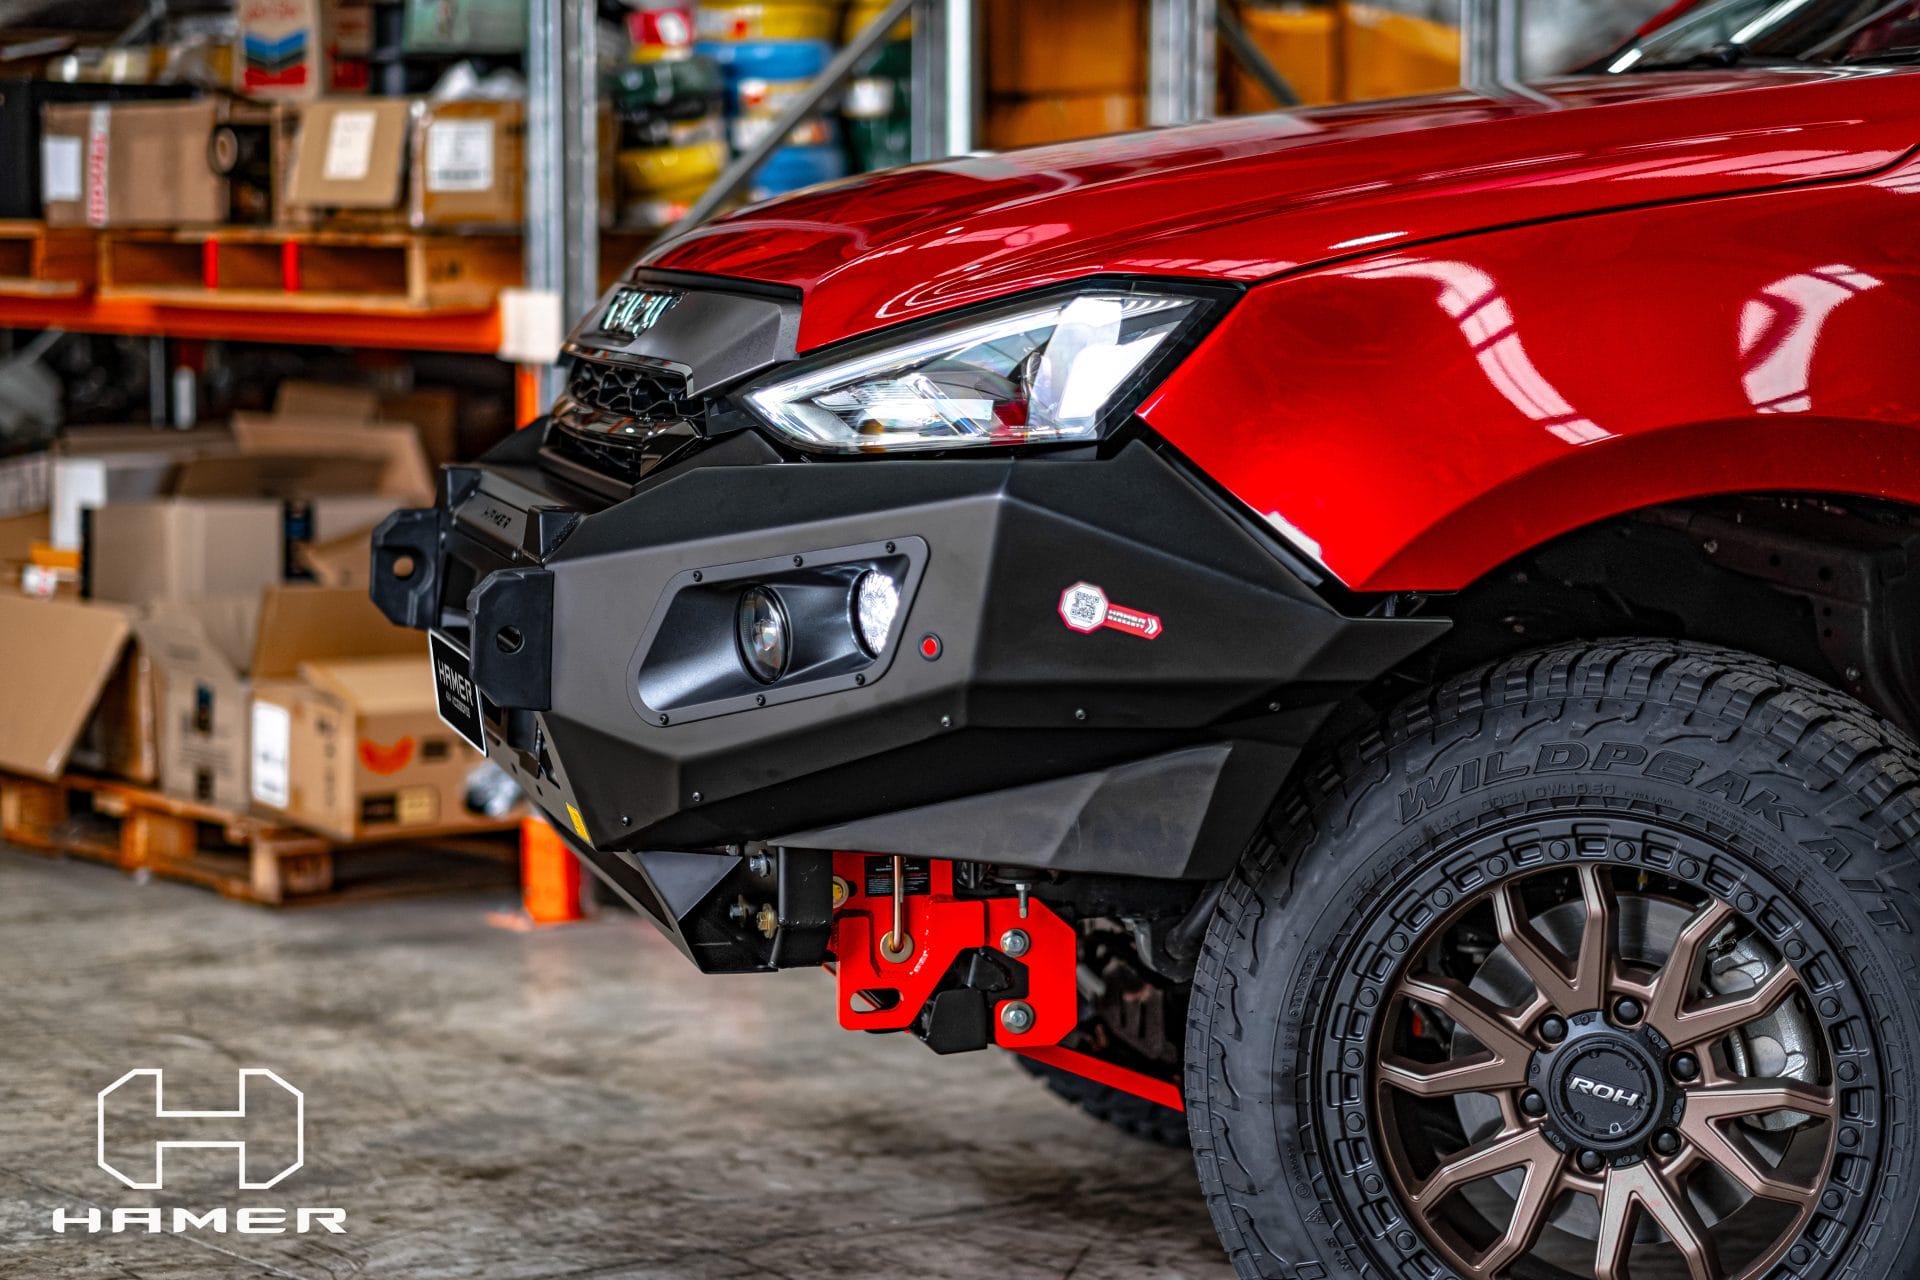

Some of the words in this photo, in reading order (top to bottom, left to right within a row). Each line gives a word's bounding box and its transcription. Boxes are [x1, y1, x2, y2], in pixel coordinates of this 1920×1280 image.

[1106, 615, 1145, 629] WARRANTY
[1108, 609, 1146, 624] HAMER
[437, 658, 474, 707] HAMER
[1397, 740, 1808, 832] WILDPEAK
[1568, 1076, 1640, 1107] ROH
